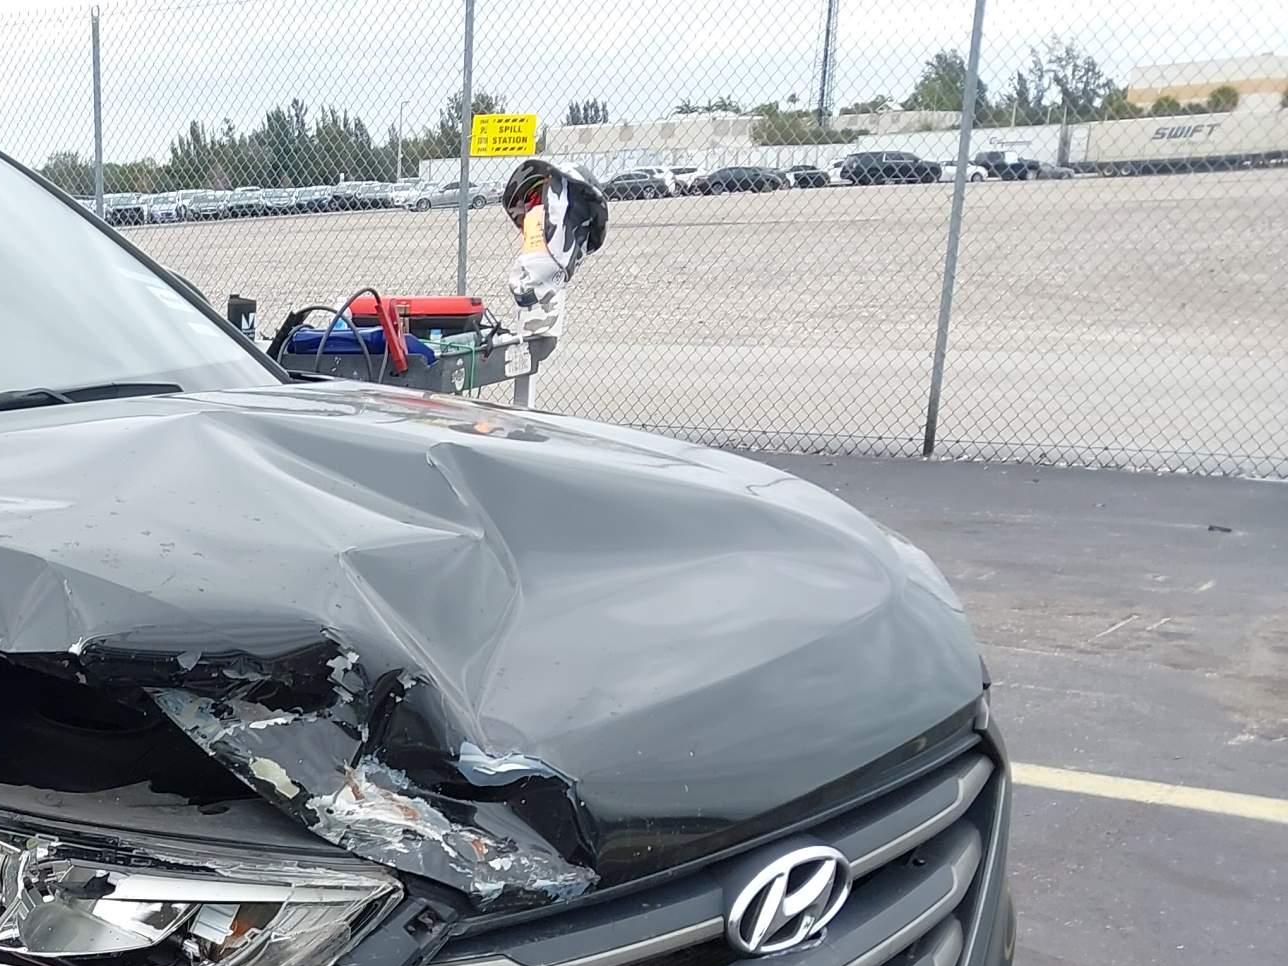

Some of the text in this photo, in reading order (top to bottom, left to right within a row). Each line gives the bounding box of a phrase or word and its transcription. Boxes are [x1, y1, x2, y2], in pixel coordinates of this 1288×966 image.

[498, 125, 523, 134] SPILL
[1151, 122, 1221, 140] SWIFT
[492, 136, 528, 145] STATION
